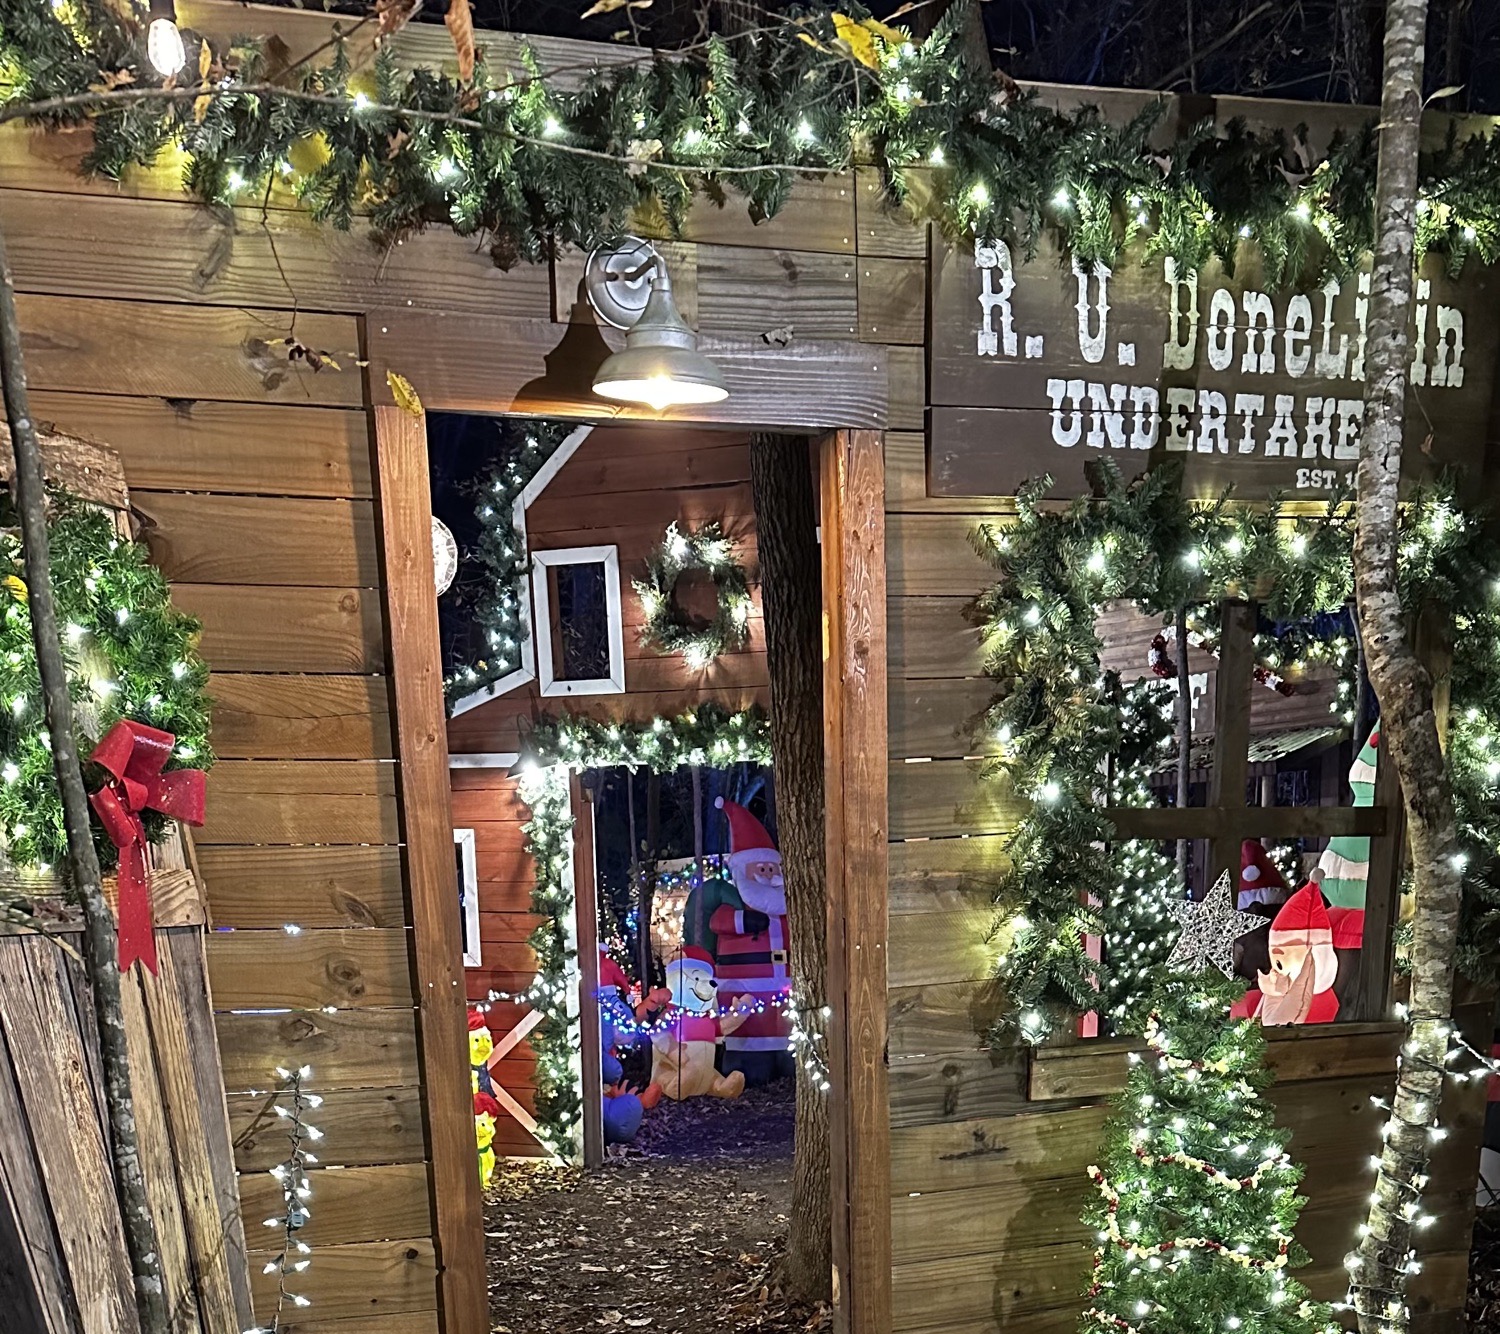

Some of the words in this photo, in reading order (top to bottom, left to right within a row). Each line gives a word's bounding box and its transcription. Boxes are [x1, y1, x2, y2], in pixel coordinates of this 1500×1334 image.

[975, 237, 1043, 358] R.
[1072, 253, 1135, 367] U.
[1163, 256, 1465, 388] DoneLiin
[1046, 378, 1364, 460] UNDERTAKE
[1296, 468, 1339, 490] EST.
